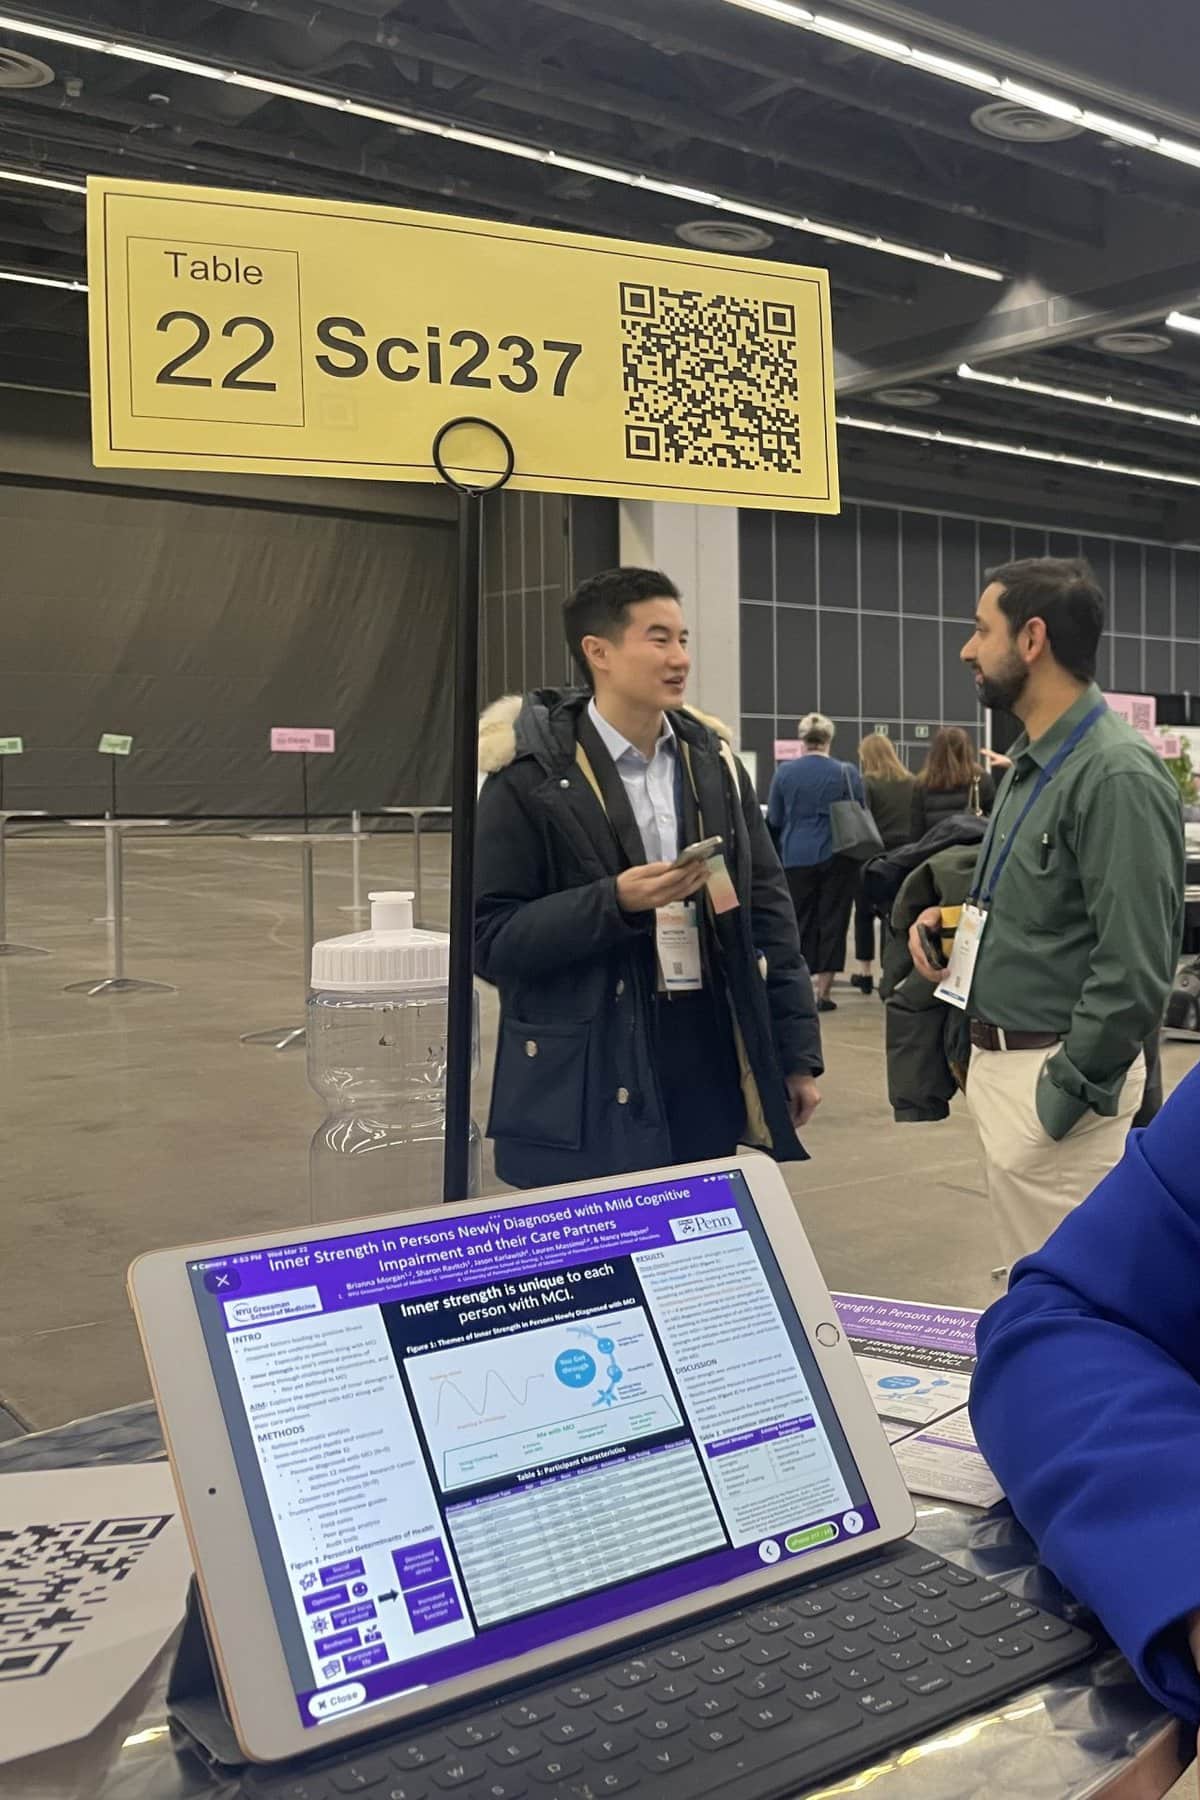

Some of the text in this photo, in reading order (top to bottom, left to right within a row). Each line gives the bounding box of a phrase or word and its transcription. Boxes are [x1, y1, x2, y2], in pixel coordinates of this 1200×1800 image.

[164, 251, 264, 286] Table
[155, 310, 583, 397] 22 Sci237
[692, 1212, 732, 1231] Penn
[269, 1188, 692, 1271] Inner Strength in Persons Newly Diagnosed with Mild Cognitive
[378, 1219, 617, 1275] Impairment and their Care Partners
[636, 1252, 664, 1262] RESULTS
[415, 1266, 441, 1276] Sharon
[399, 1263, 614, 1317] Inner strength is unique to each
[236, 1307, 251, 1315] NYU
[458, 1288, 574, 1324] person with MCI.
[876, 1307, 886, 1315] in
[888, 1308, 932, 1322] Persons
[935, 1315, 968, 1327] Newly
[406, 1342, 428, 1353] Figure
[437, 1335, 464, 1347] Themes
[465, 1333, 473, 1341] of
[473, 1329, 492, 1339] Inner
[492, 1323, 520, 1335] Strength
[528, 1316, 554, 1327] Persons
[554, 1311, 575, 1321] Newly
[575, 1304, 608, 1317] Diagnosed
[608, 1301, 623, 1310] with
[622, 1298, 636, 1306] MCI
[858, 1316, 922, 1332] Impairment
[924, 1326, 946, 1335] and
[232, 1332, 262, 1344] INTRO
[864, 1346, 904, 1358] person
[906, 1352, 932, 1361] with
[868, 1340, 916, 1353] strength
[929, 1350, 969, 1361] unique
[675, 1358, 717, 1373] DISCUSSION
[257, 1425, 305, 1442] METHODS
[517, 1470, 535, 1481] Table
[544, 1458, 579, 1474] Participant
[580, 1445, 626, 1463] characteristics
[291, 1558, 313, 1570] Figure
[322, 1547, 353, 1561] Personal
[803, 1631, 815, 1639] O
[712, 1666, 725, 1675] U
[799, 1662, 812, 1671] K
[664, 1684, 675, 1693] Y
[805, 1691, 821, 1700] M
[330, 1689, 358, 1706] Close
[705, 1700, 719, 1710] H
[613, 1704, 624, 1712] T
[561, 1725, 575, 1734] R
[602, 1742, 612, 1750] F
[657, 1752, 670, 1762] V
[605, 1776, 618, 1785] C
